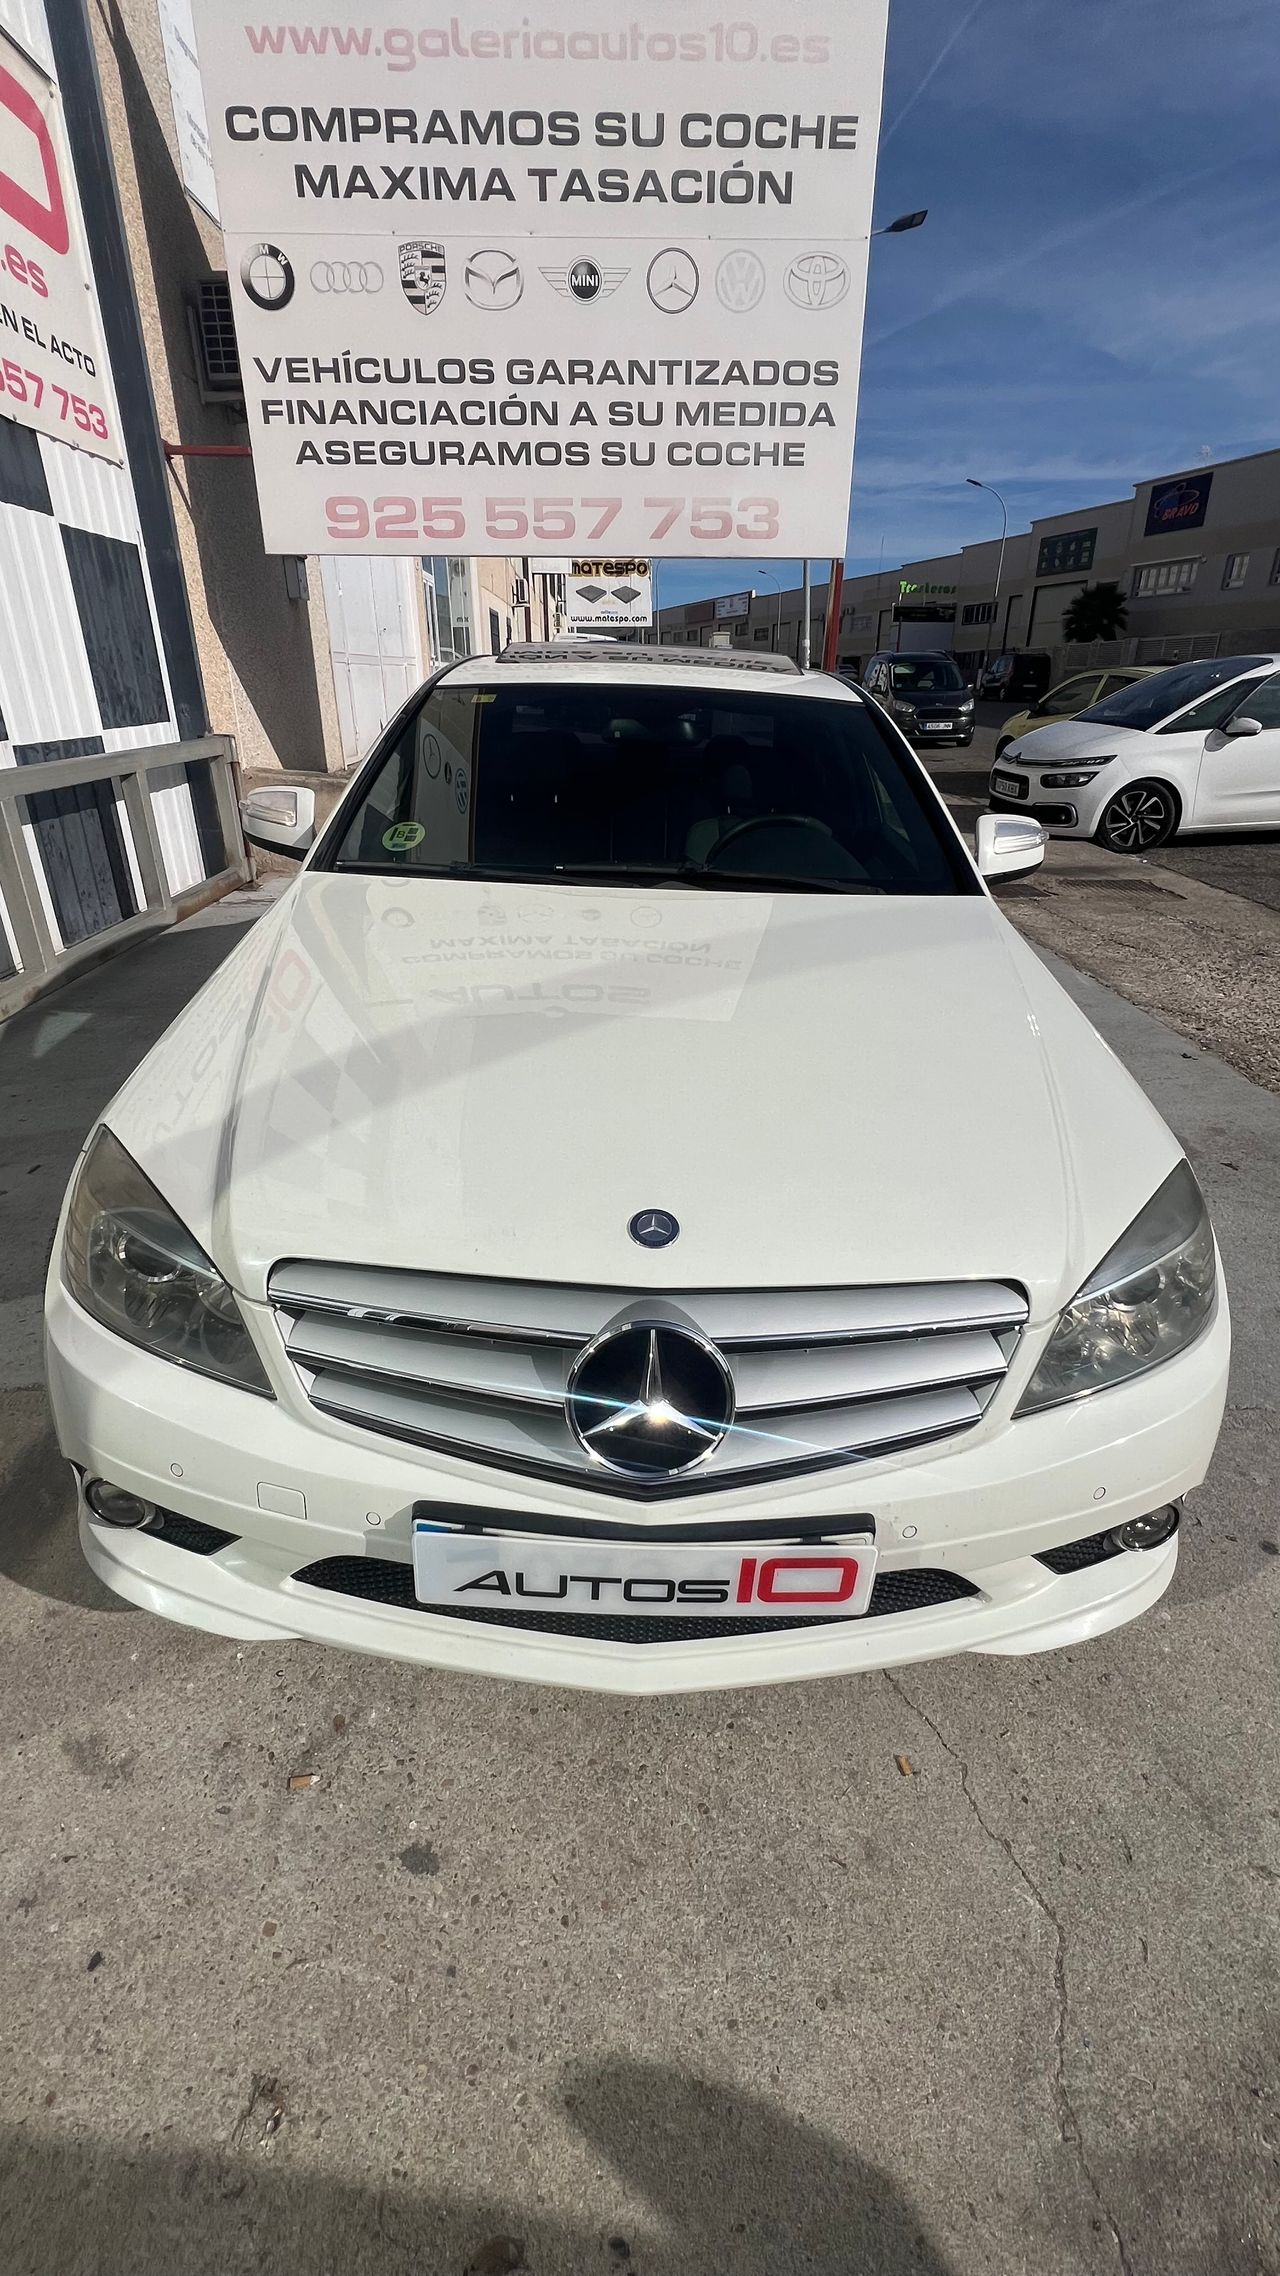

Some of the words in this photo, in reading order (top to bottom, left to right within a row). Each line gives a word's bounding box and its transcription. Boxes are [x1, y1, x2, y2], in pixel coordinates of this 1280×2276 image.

[244, 17, 832, 73] www.galeriaautos10.es
[224, 106, 580, 147] COMPRAMOS
[595, 112, 665, 148] SU
[681, 113, 859, 150] COCHE
[295, 165, 517, 202] MAXIMA
[528, 160, 793, 205] TASACIÓN
[571, 273, 599, 287] MINI
[21, 315, 46, 350] EL
[50, 334, 96, 378] ACTO
[253, 350, 495, 385] VEHÍCULOS
[507, 359, 839, 387] GARANTIZADOS
[51, 384, 109, 440] 753
[261, 393, 559, 426] FINANCIACIÓN
[570, 401, 599, 427] A
[609, 401, 664, 427] SU
[676, 402, 836, 427] MEDIDA
[296, 441, 590, 466] ASEGURAMOS
[602, 442, 656, 467] SU
[668, 442, 806, 467] COCHE
[324, 496, 467, 541] 925
[484, 497, 623, 541] 557
[643, 498, 780, 541] 753
[570, 614, 648, 624] www.matespo.com
